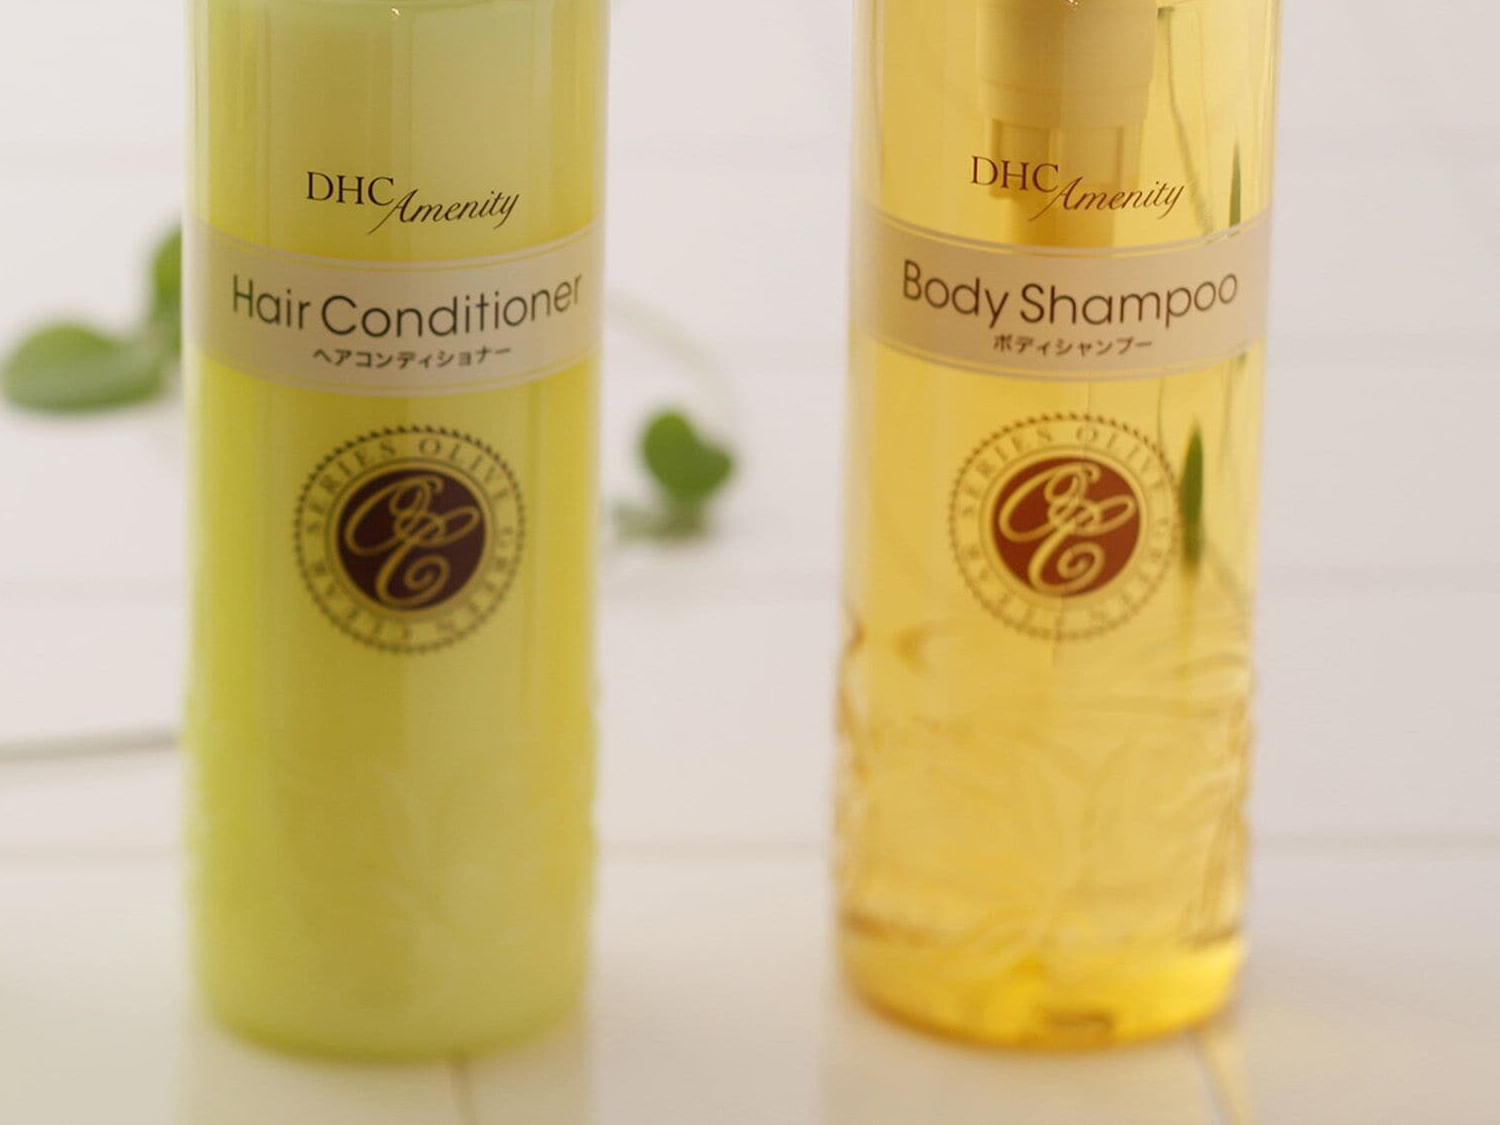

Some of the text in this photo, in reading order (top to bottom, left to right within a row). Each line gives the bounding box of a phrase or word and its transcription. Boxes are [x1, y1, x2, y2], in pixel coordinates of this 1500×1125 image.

[306, 171, 520, 235] DHC Amenity
[970, 154, 1187, 222] DHC Amenity
[232, 273, 584, 339] Hair Conditioner
[903, 259, 1239, 331] Body Shampoo
[312, 345, 512, 370] ヘアコンディショナー
[993, 333, 1154, 357] ボディシャンプー
